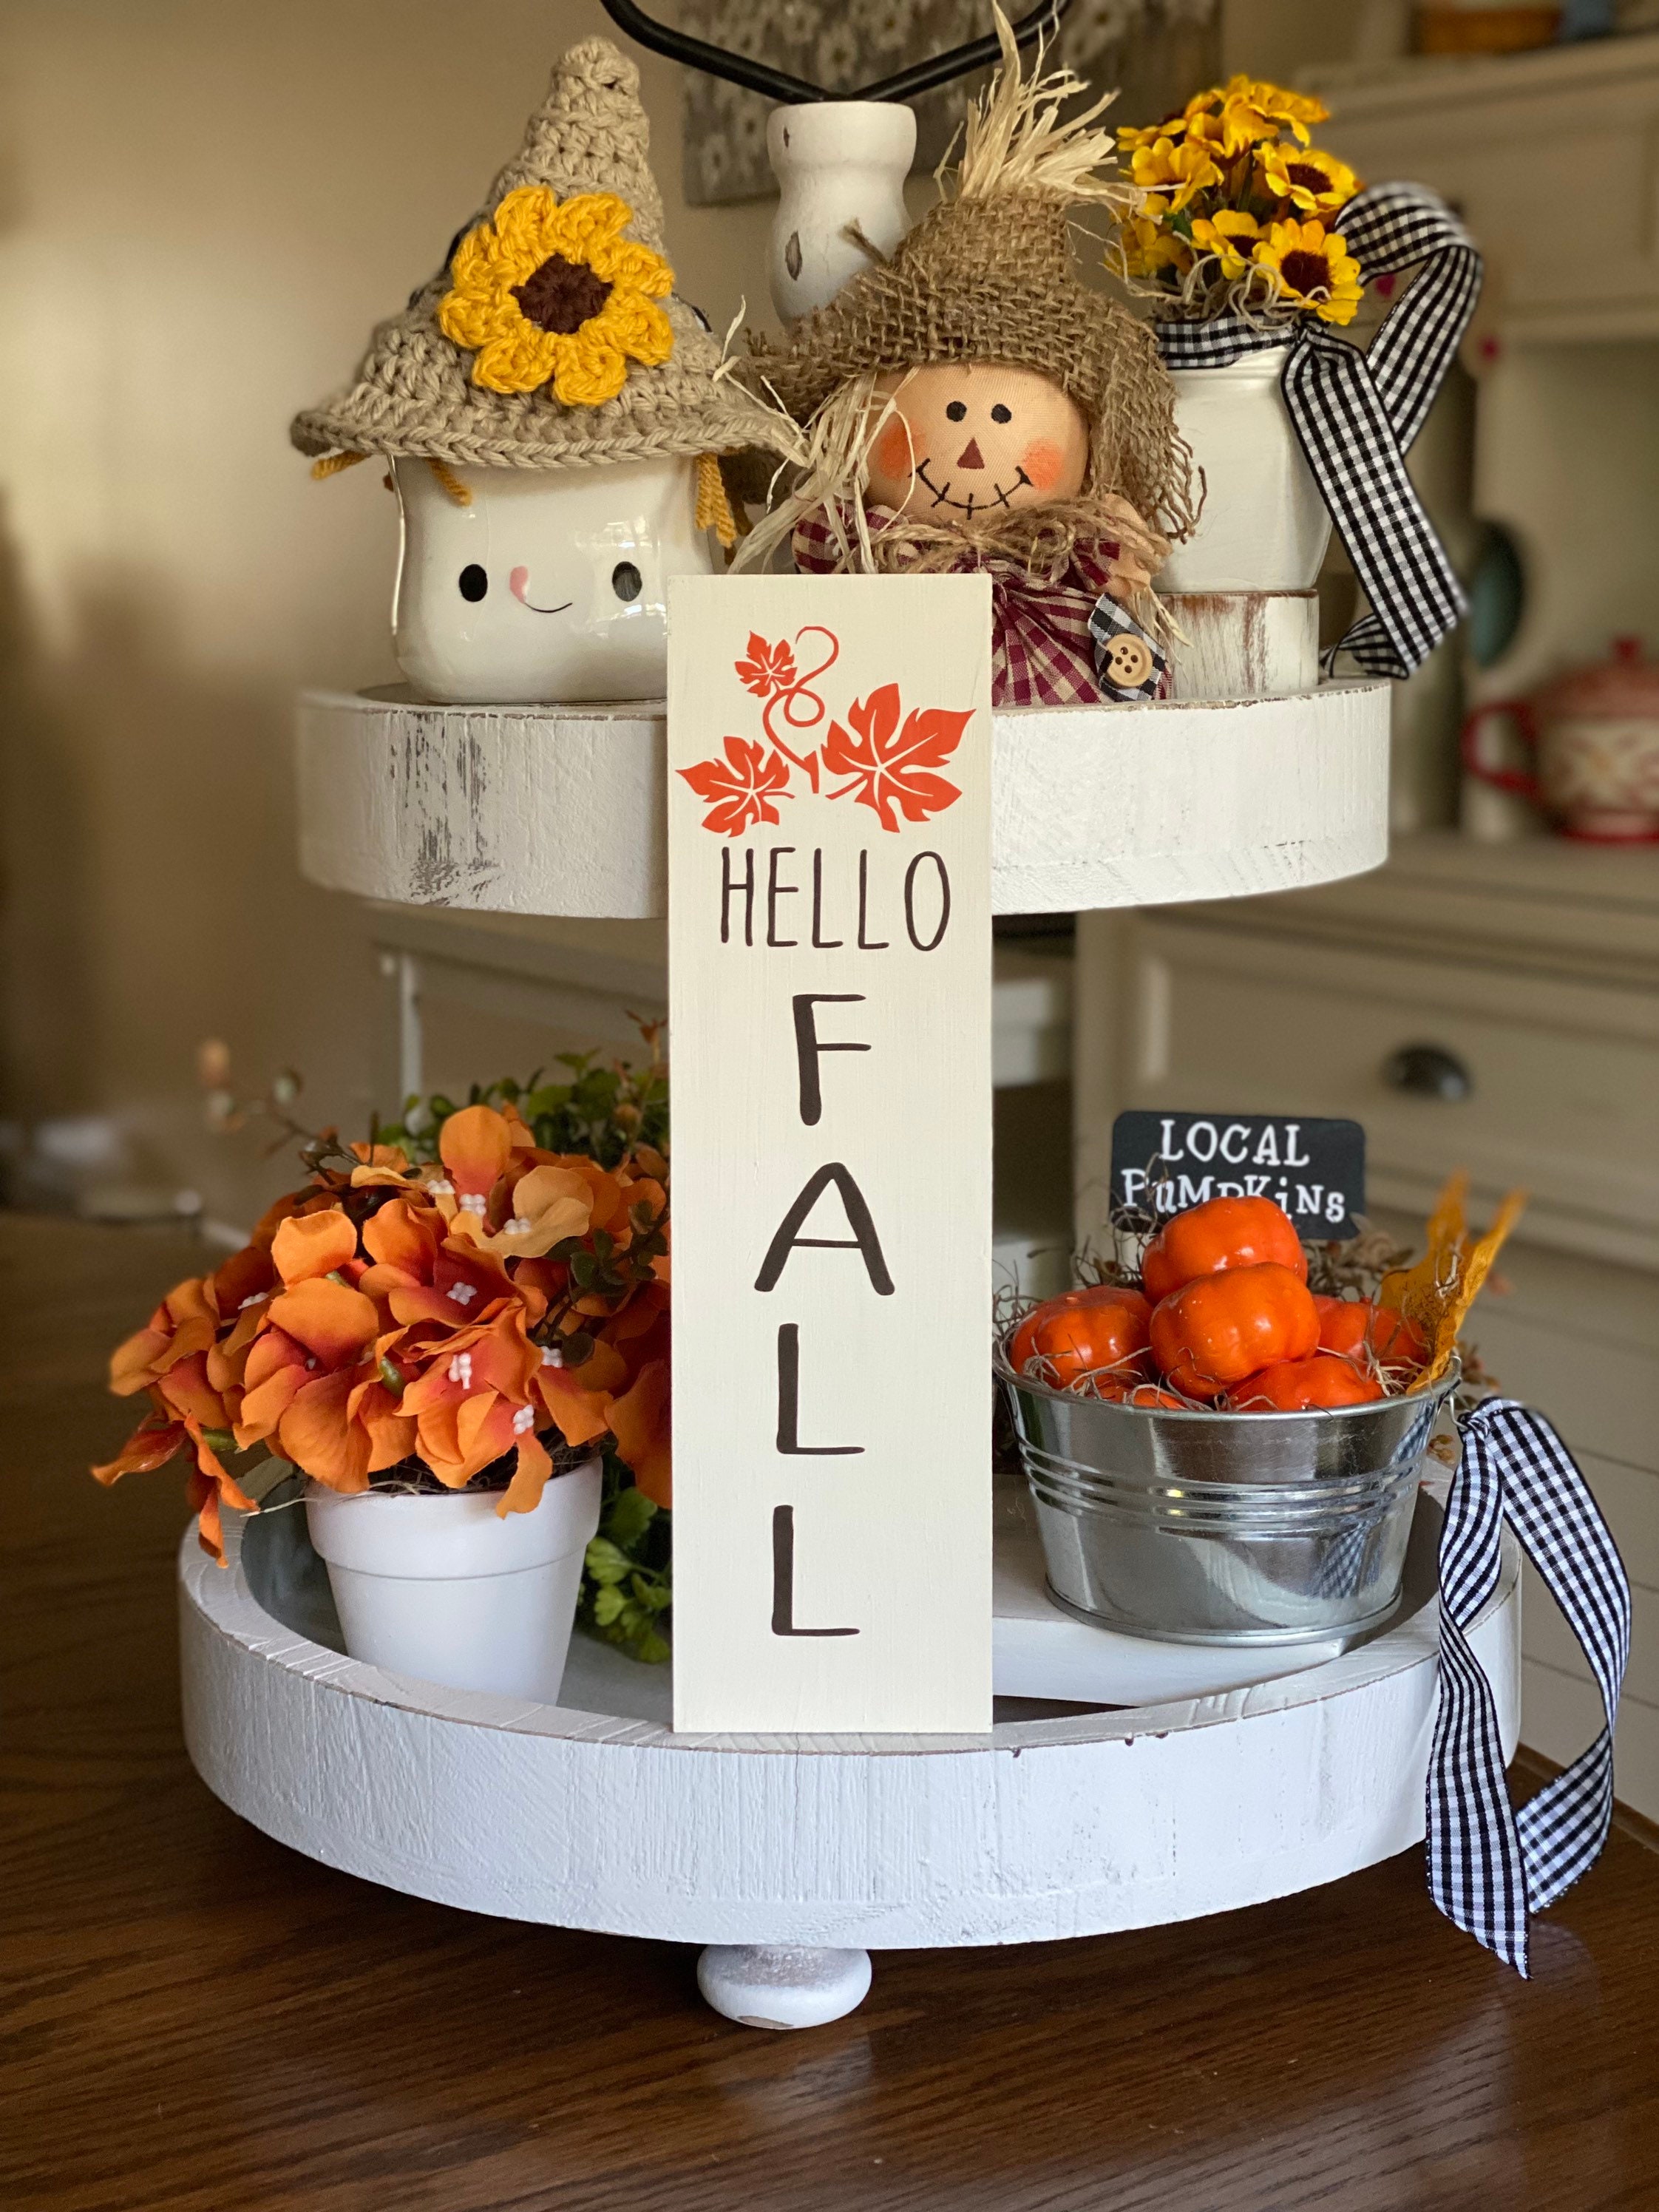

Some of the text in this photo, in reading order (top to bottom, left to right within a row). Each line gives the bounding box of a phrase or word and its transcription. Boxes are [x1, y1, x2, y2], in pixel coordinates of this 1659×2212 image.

[721, 847, 951, 951] HELLO
[1159, 1119, 1310, 1167] LOCAL
[754, 993, 895, 1638] FALL
